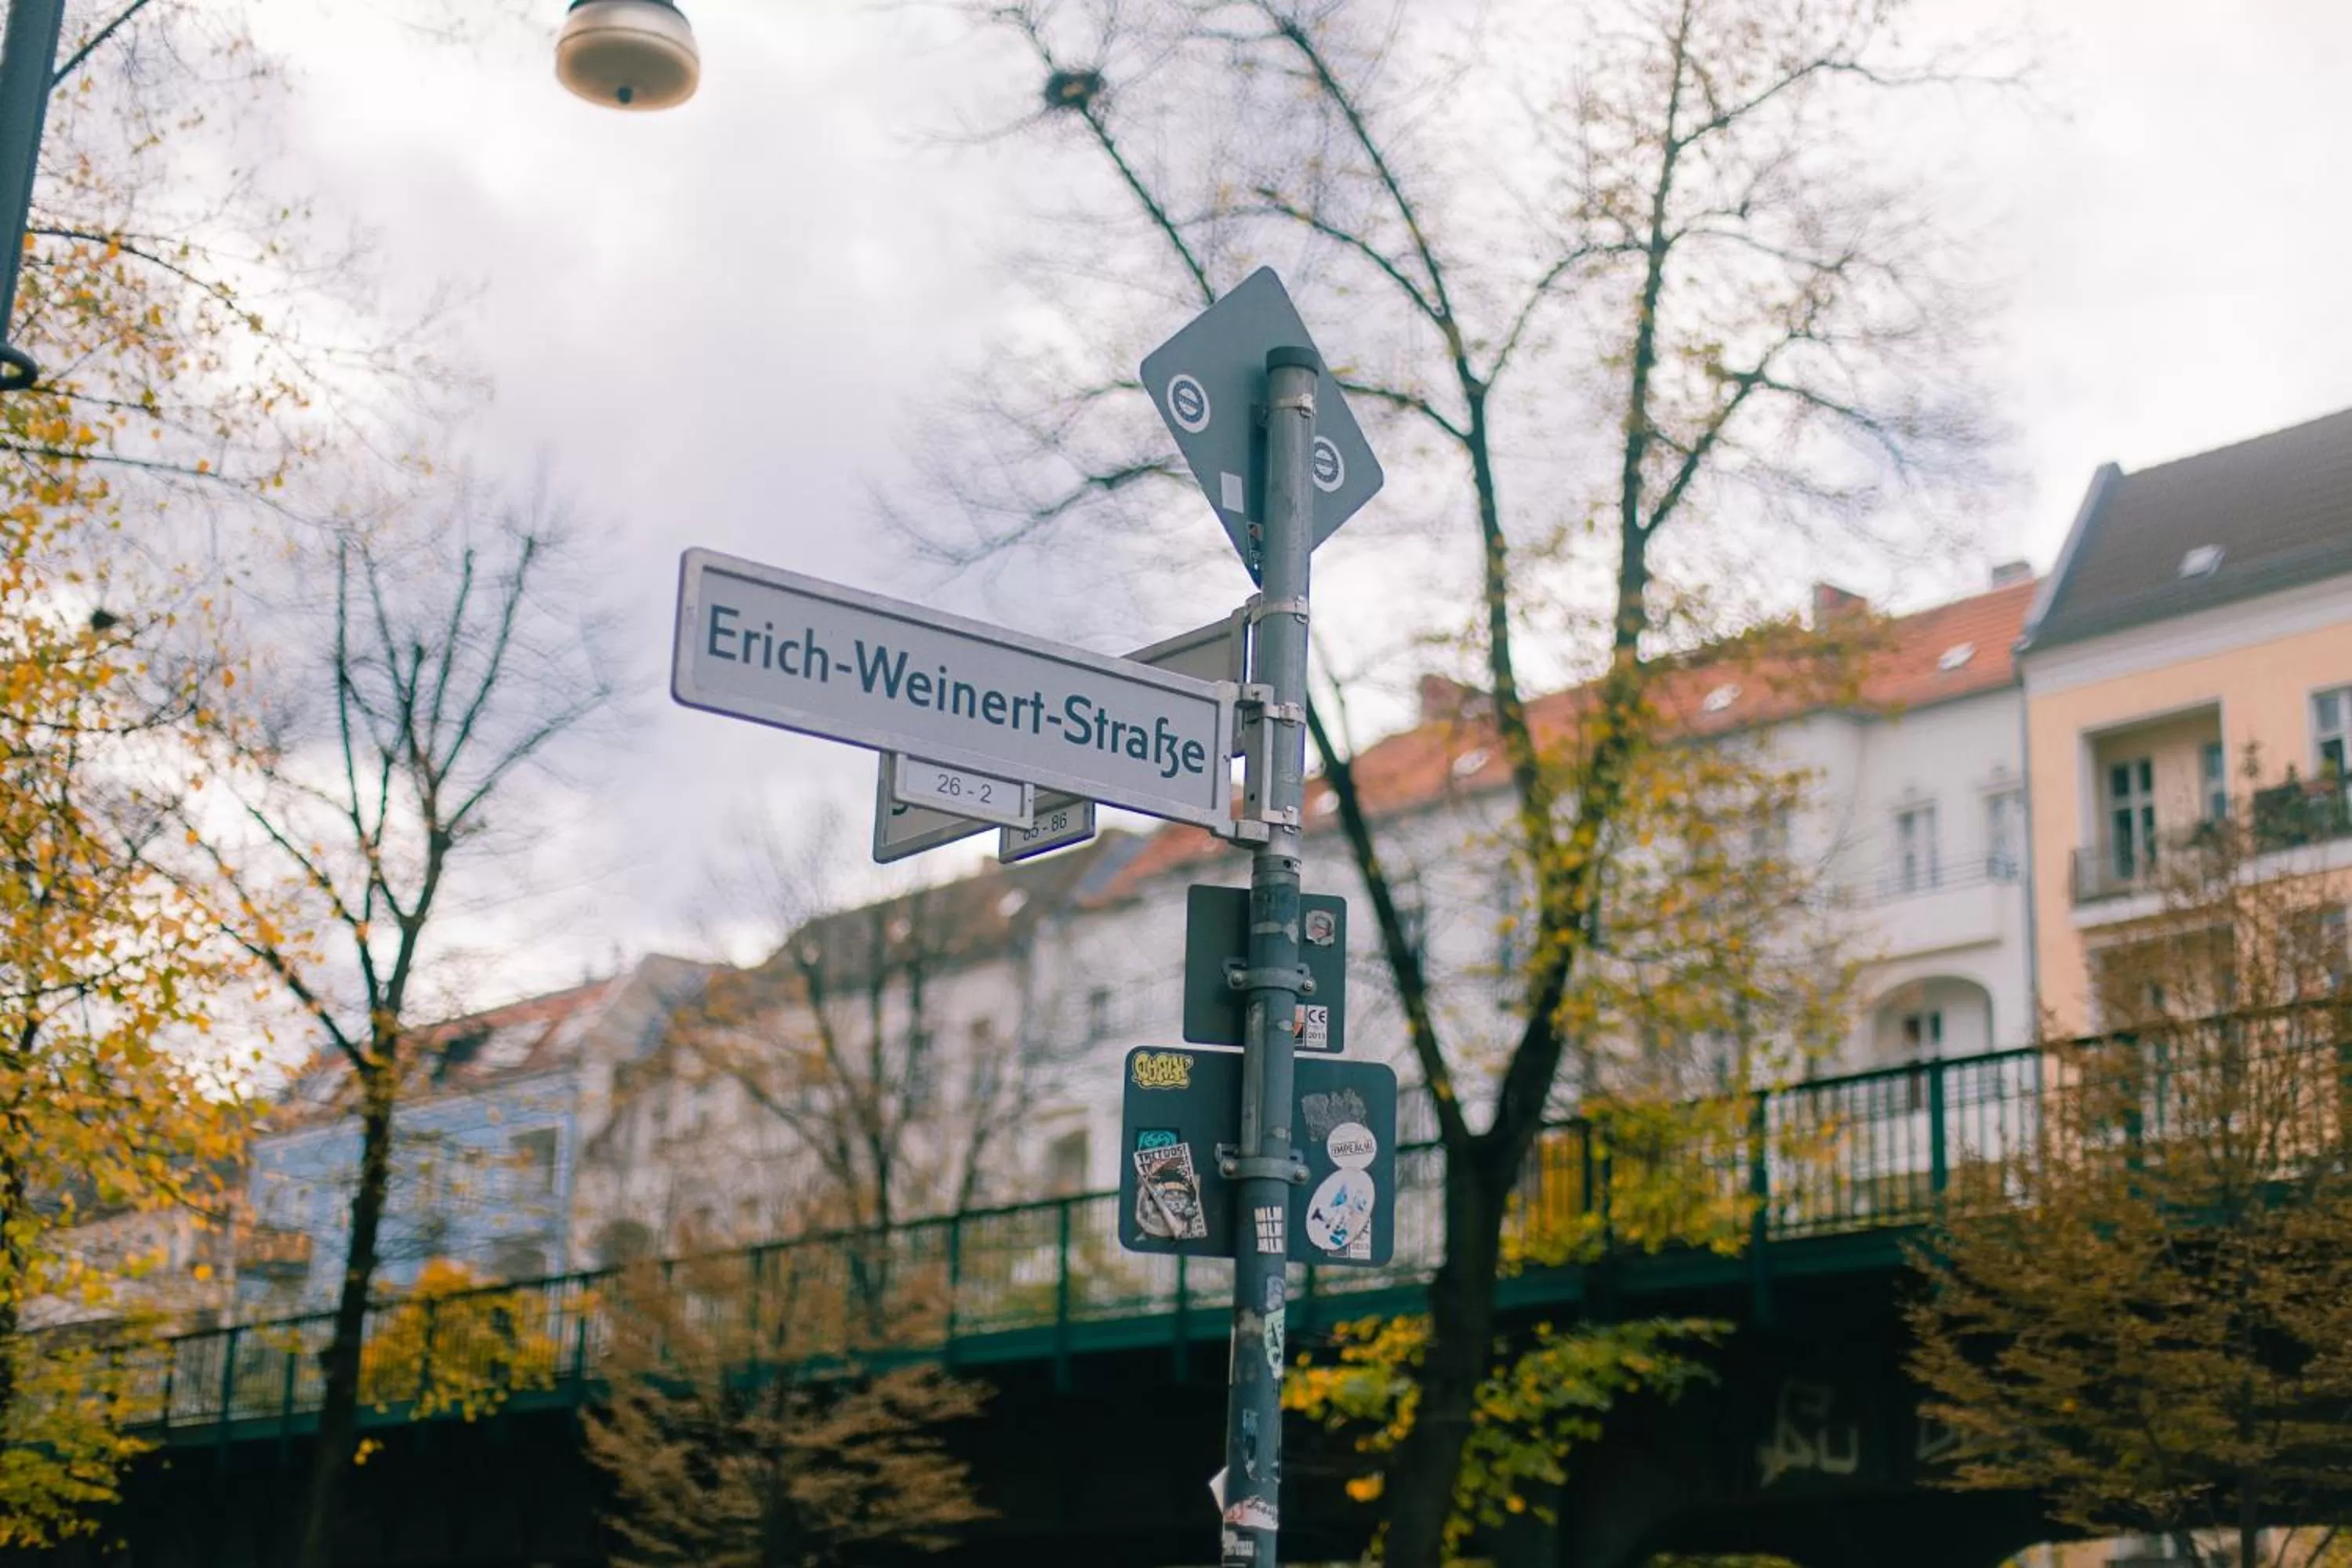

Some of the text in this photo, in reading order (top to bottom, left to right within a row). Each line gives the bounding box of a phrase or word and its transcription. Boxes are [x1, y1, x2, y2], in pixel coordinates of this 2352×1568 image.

[707, 604, 1206, 779] Erich-Weinert-Straße
[936, 774, 961, 797] 26
[979, 783, 993, 804] 2
[1051, 811, 1067, 832] 86
[1308, 1009, 1327, 1024] CE
